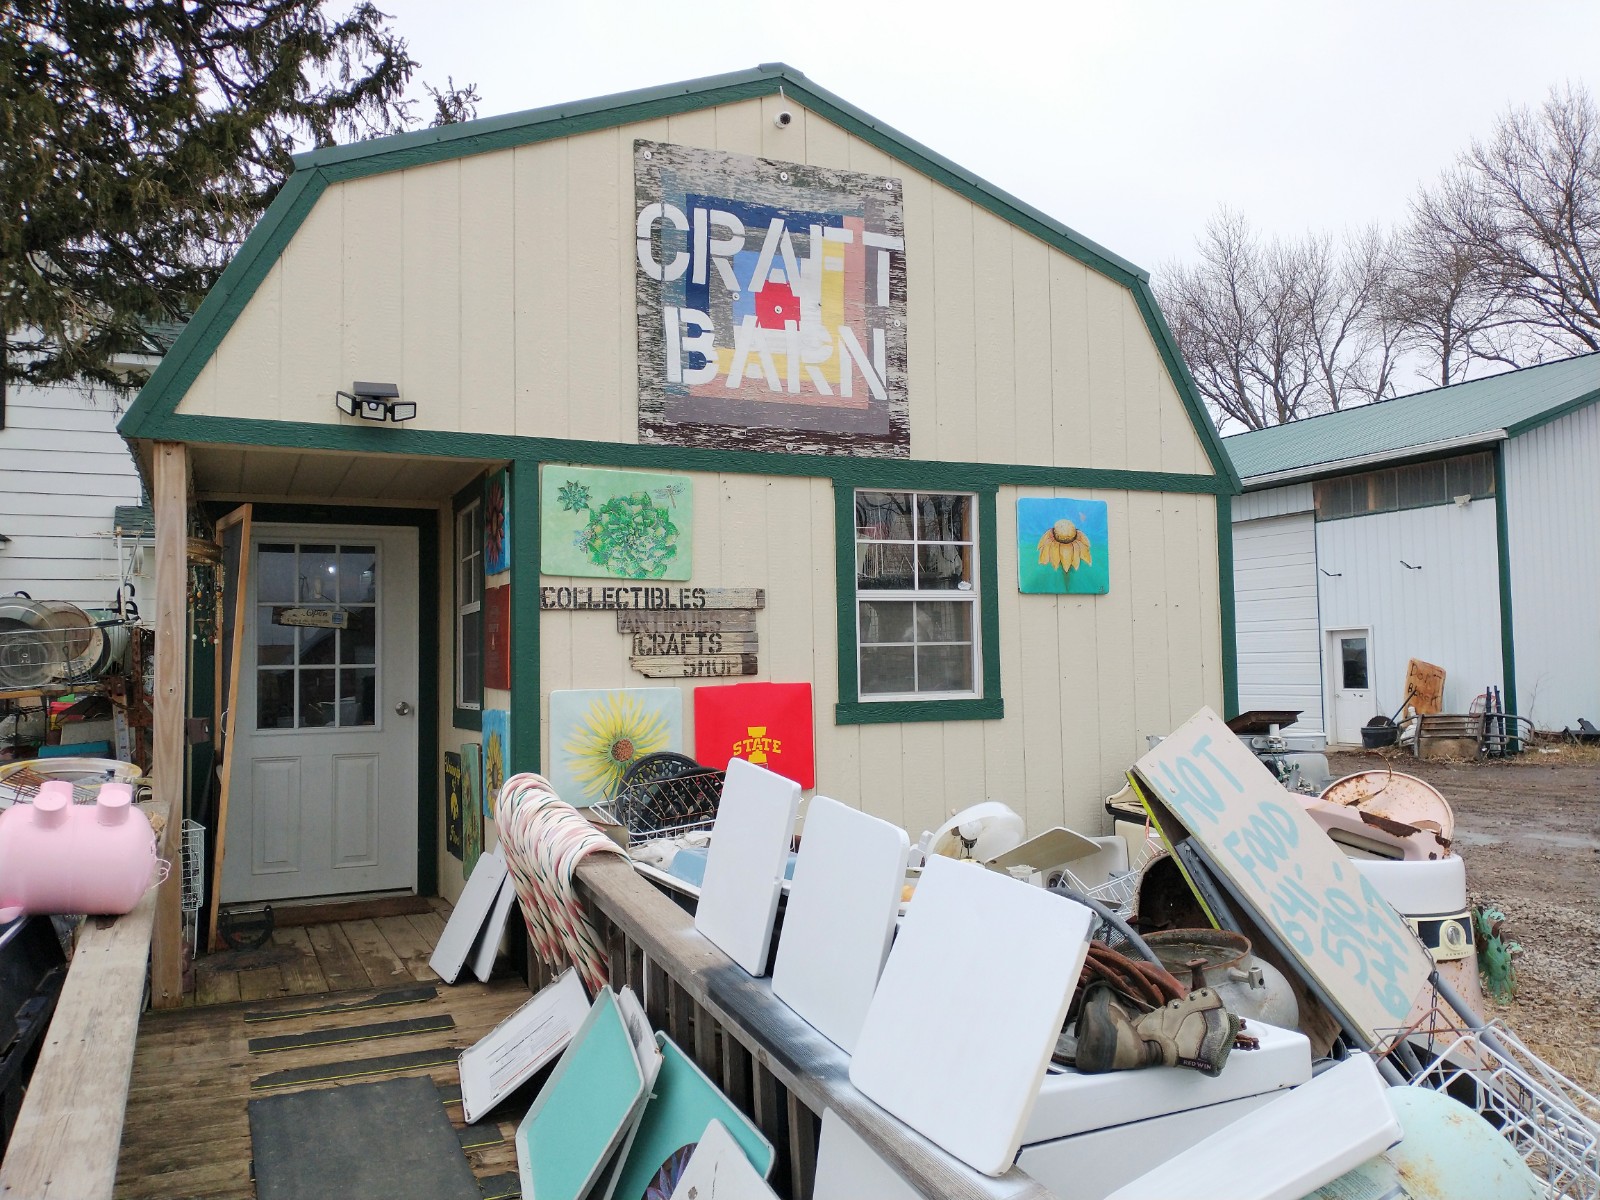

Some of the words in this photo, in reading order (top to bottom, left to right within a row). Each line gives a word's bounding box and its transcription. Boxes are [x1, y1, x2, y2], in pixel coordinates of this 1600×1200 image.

[637, 203, 904, 307] CRAFT
[664, 306, 888, 400] BARN
[541, 587, 706, 611] COLLECTIBLES
[621, 610, 722, 633] ANTIQUES
[637, 632, 723, 656] CRAFTS
[683, 658, 740, 677] SHOP
[732, 737, 782, 756] STATE
[1150, 735, 1245, 831] HOT
[1222, 800, 1300, 894] FOOD
